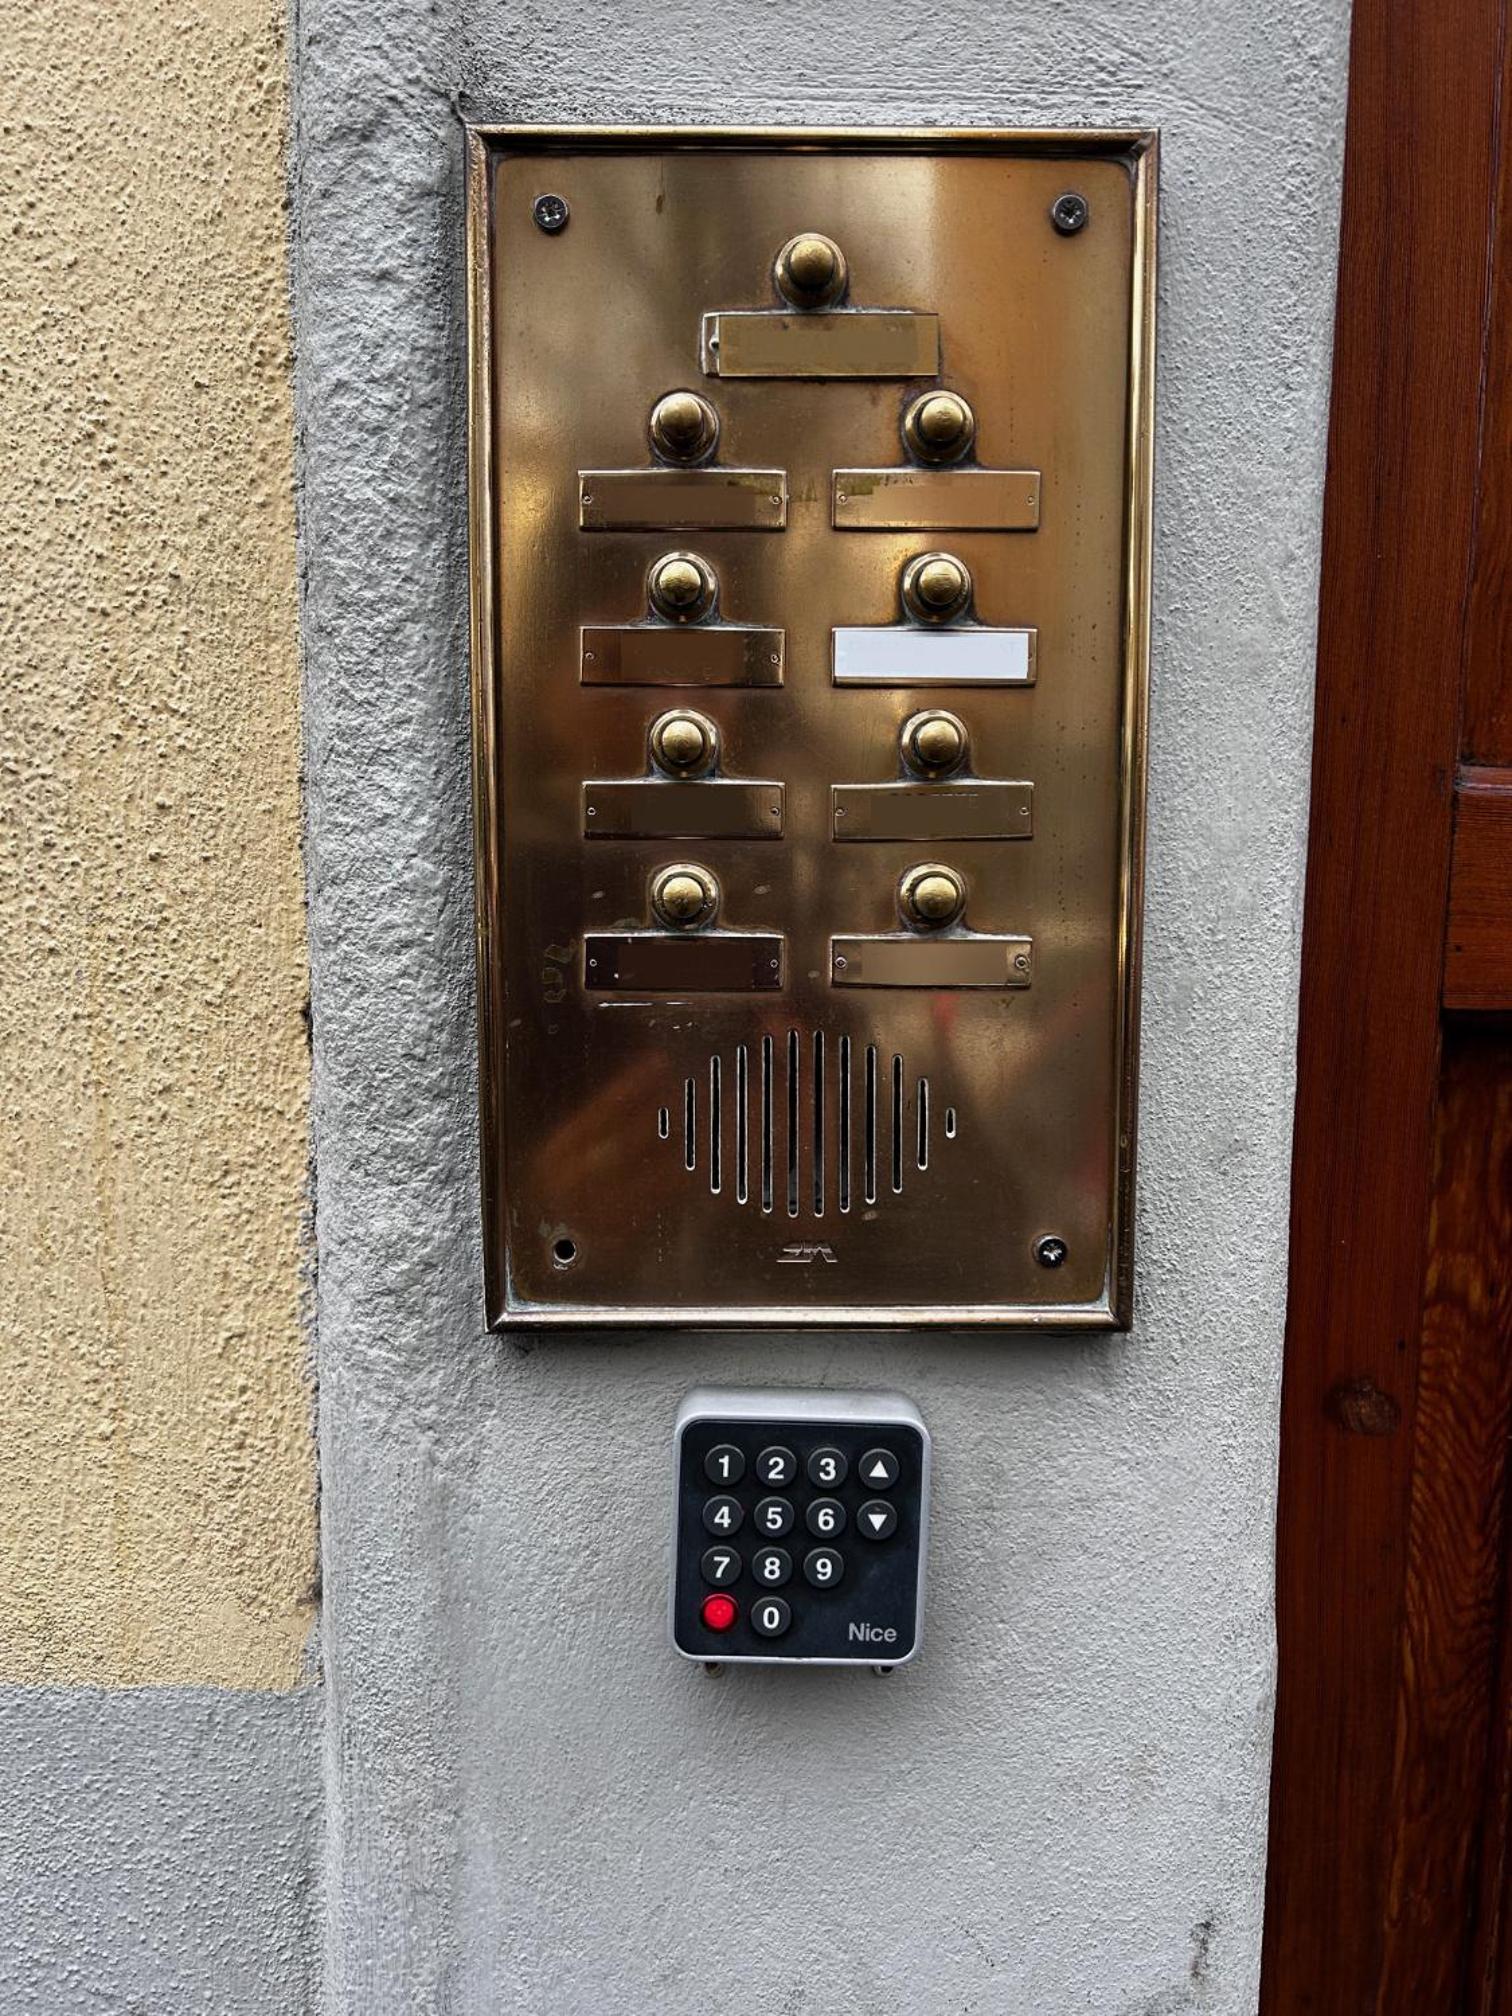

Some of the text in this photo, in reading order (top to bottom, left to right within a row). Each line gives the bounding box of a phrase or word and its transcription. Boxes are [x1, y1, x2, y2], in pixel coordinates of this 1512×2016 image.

[718, 1455, 837, 1481] 1 2 3
[713, 1505, 835, 1531] 4 5 6
[713, 1556, 833, 1581] 7 8 9
[762, 1606, 780, 1629] 0
[848, 1623, 897, 1643] Nice
